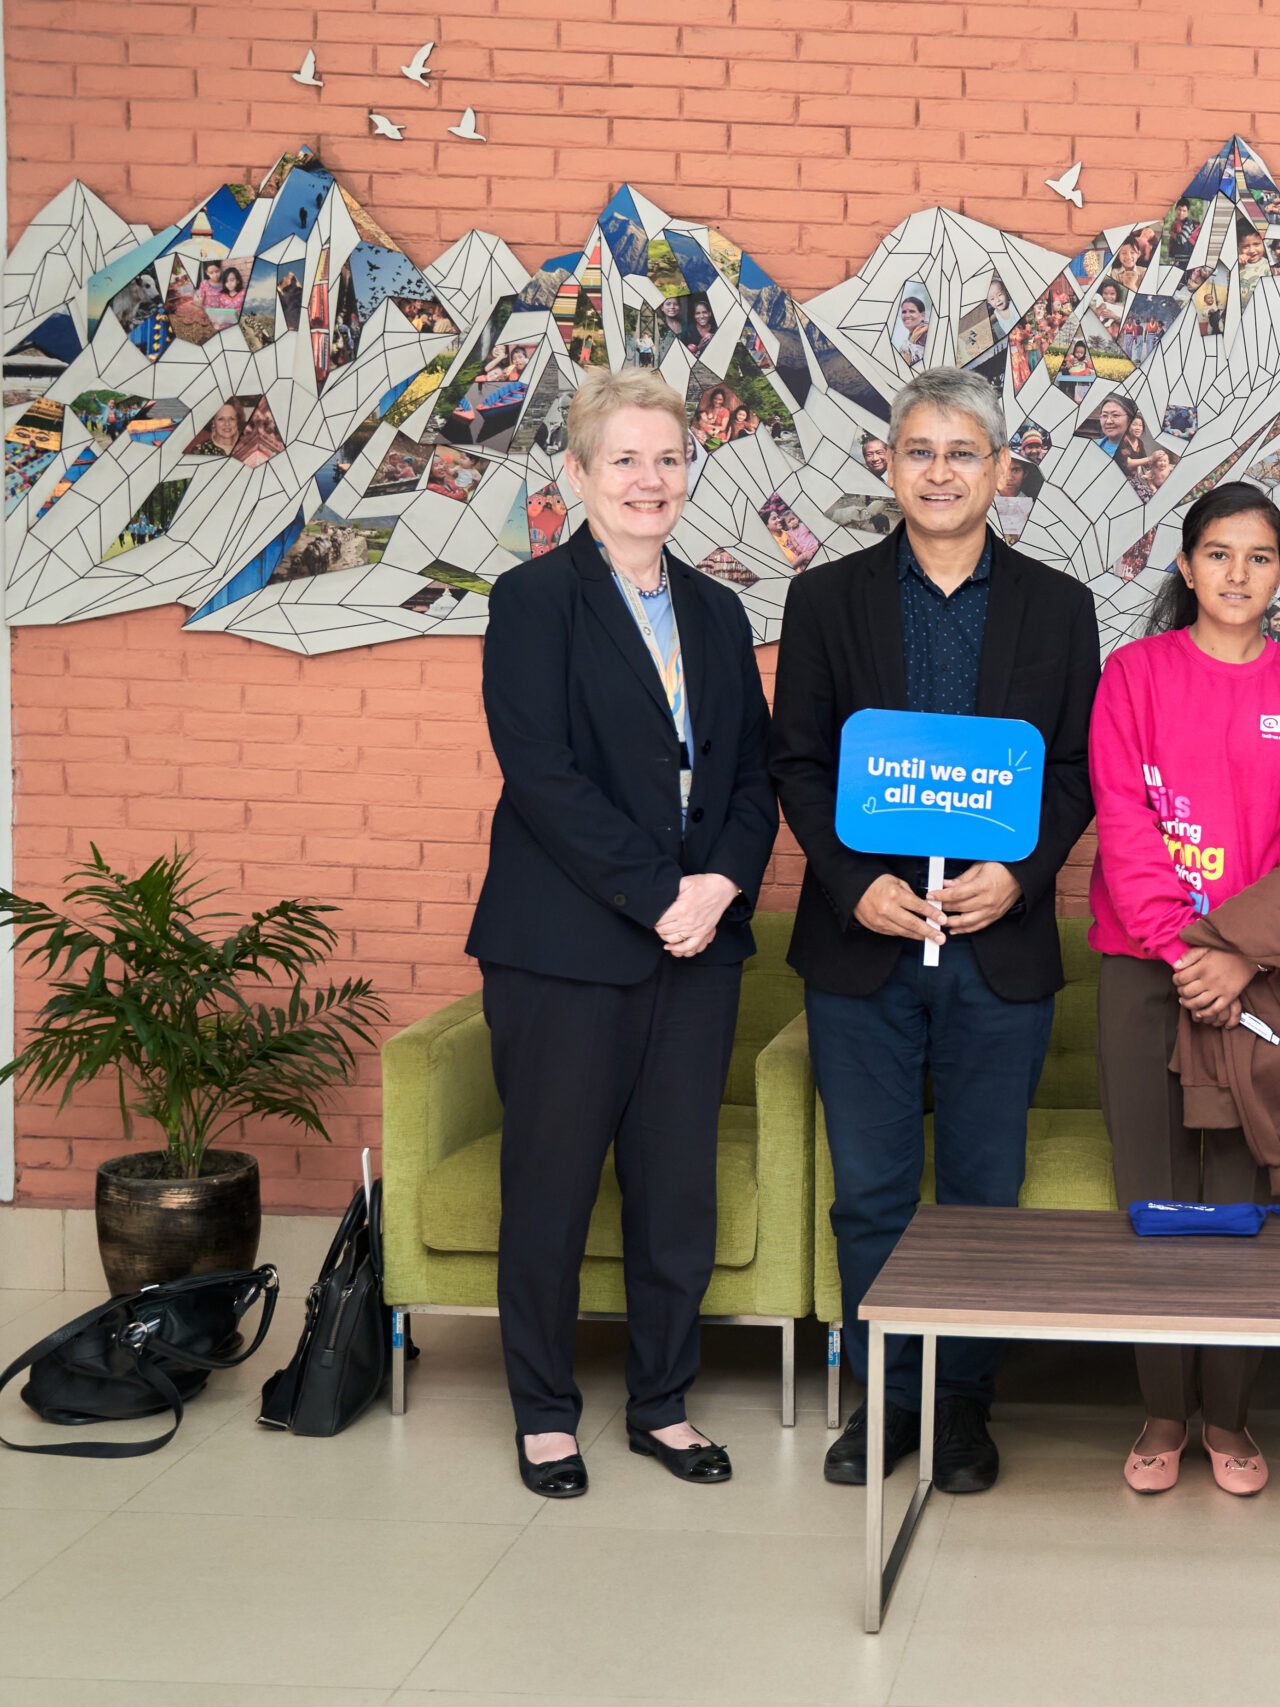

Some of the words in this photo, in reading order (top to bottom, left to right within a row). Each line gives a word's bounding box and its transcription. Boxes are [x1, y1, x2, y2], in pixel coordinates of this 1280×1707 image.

[868, 756, 925, 779] Until
[930, 765, 967, 782] we
[971, 768, 1013, 786] are
[884, 784, 916, 804] all
[921, 790, 992, 813] equal
